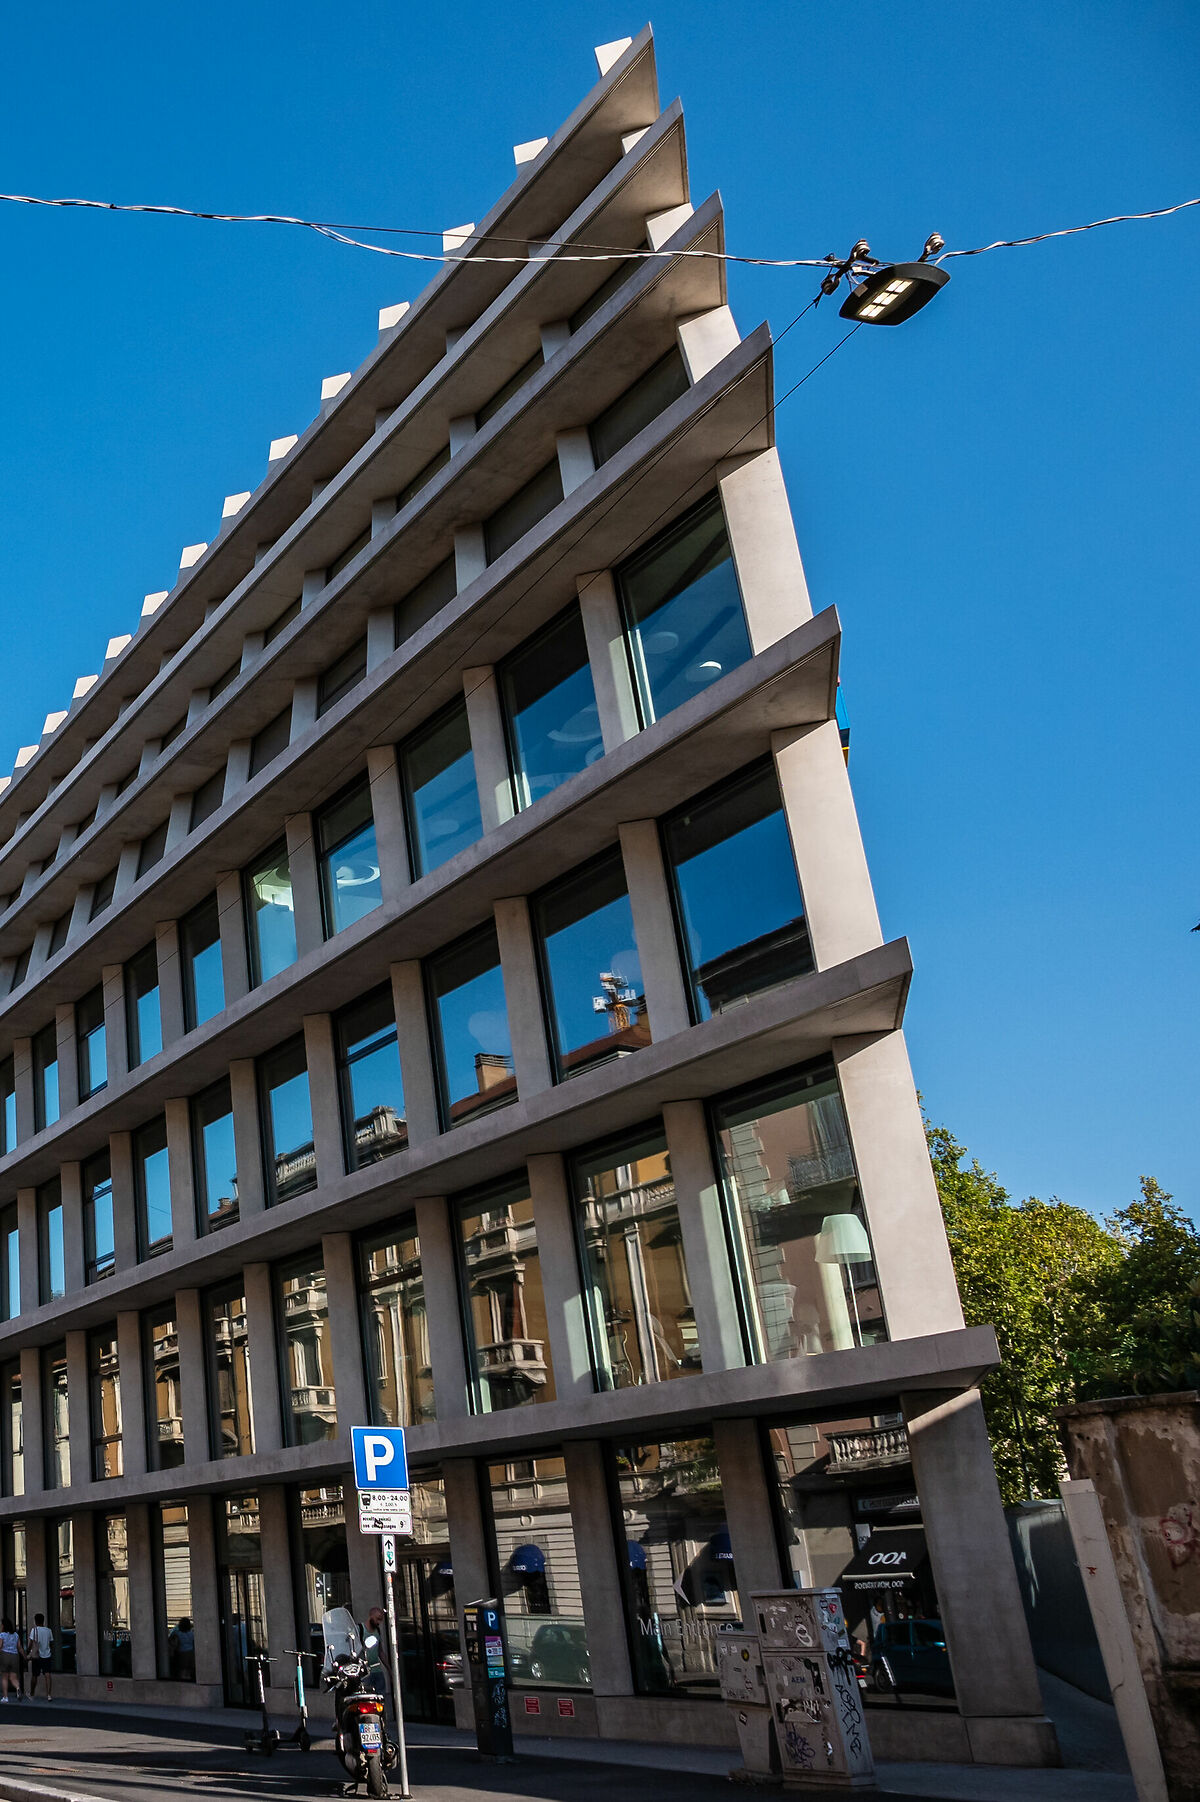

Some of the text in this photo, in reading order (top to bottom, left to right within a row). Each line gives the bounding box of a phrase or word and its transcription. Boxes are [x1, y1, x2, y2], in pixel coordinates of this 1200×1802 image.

[363, 1435, 395, 1481] P
[487, 1611, 496, 1627] P
[638, 1617, 734, 1637] Main Entrance
